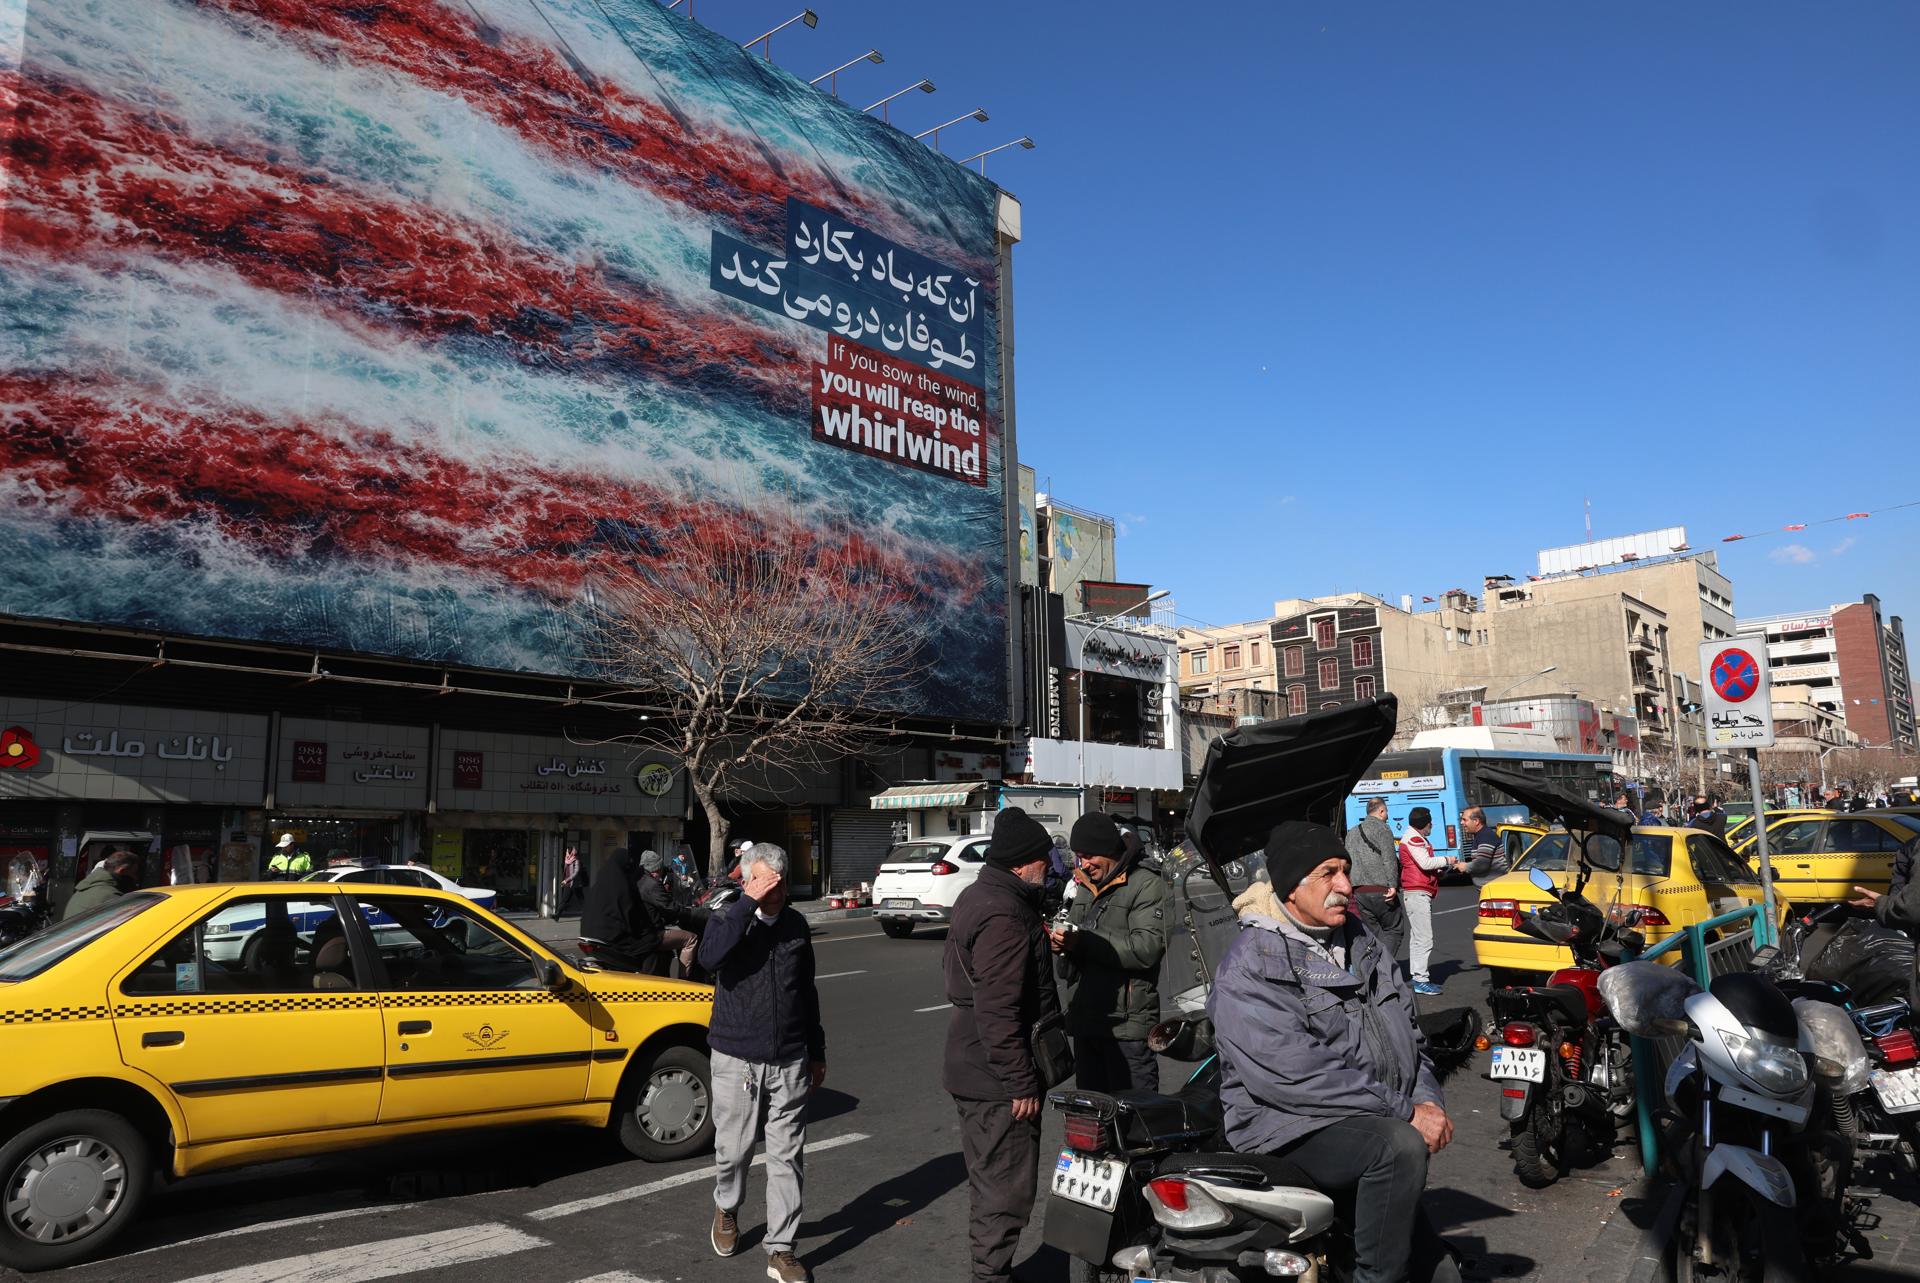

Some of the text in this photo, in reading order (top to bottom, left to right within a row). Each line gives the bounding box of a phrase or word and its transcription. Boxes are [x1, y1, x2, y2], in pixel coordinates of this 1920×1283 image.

[795, 220, 979, 323] آن که باد بکارد
[881, 310, 976, 369] طوفان
[833, 343, 980, 411] If you sow the wind,
[820, 368, 980, 436] you will reap the
[820, 404, 980, 480] whirlwind
[1049, 666, 1061, 738] SAMSUNG
[63, 731, 145, 758] ملت
[1747, 730, 1764, 739] حمل
[298, 746, 323, 755] 984
[343, 747, 416, 760] ساعت فروشی
[354, 764, 416, 783] ساعتی
[537, 757, 606, 777] کفش ملی
[520, 780, 548, 791] انقلاب
[1511, 1050, 1538, 1063] ۱۵۳
[1494, 1064, 1540, 1078] ۷۷۱۱۶
